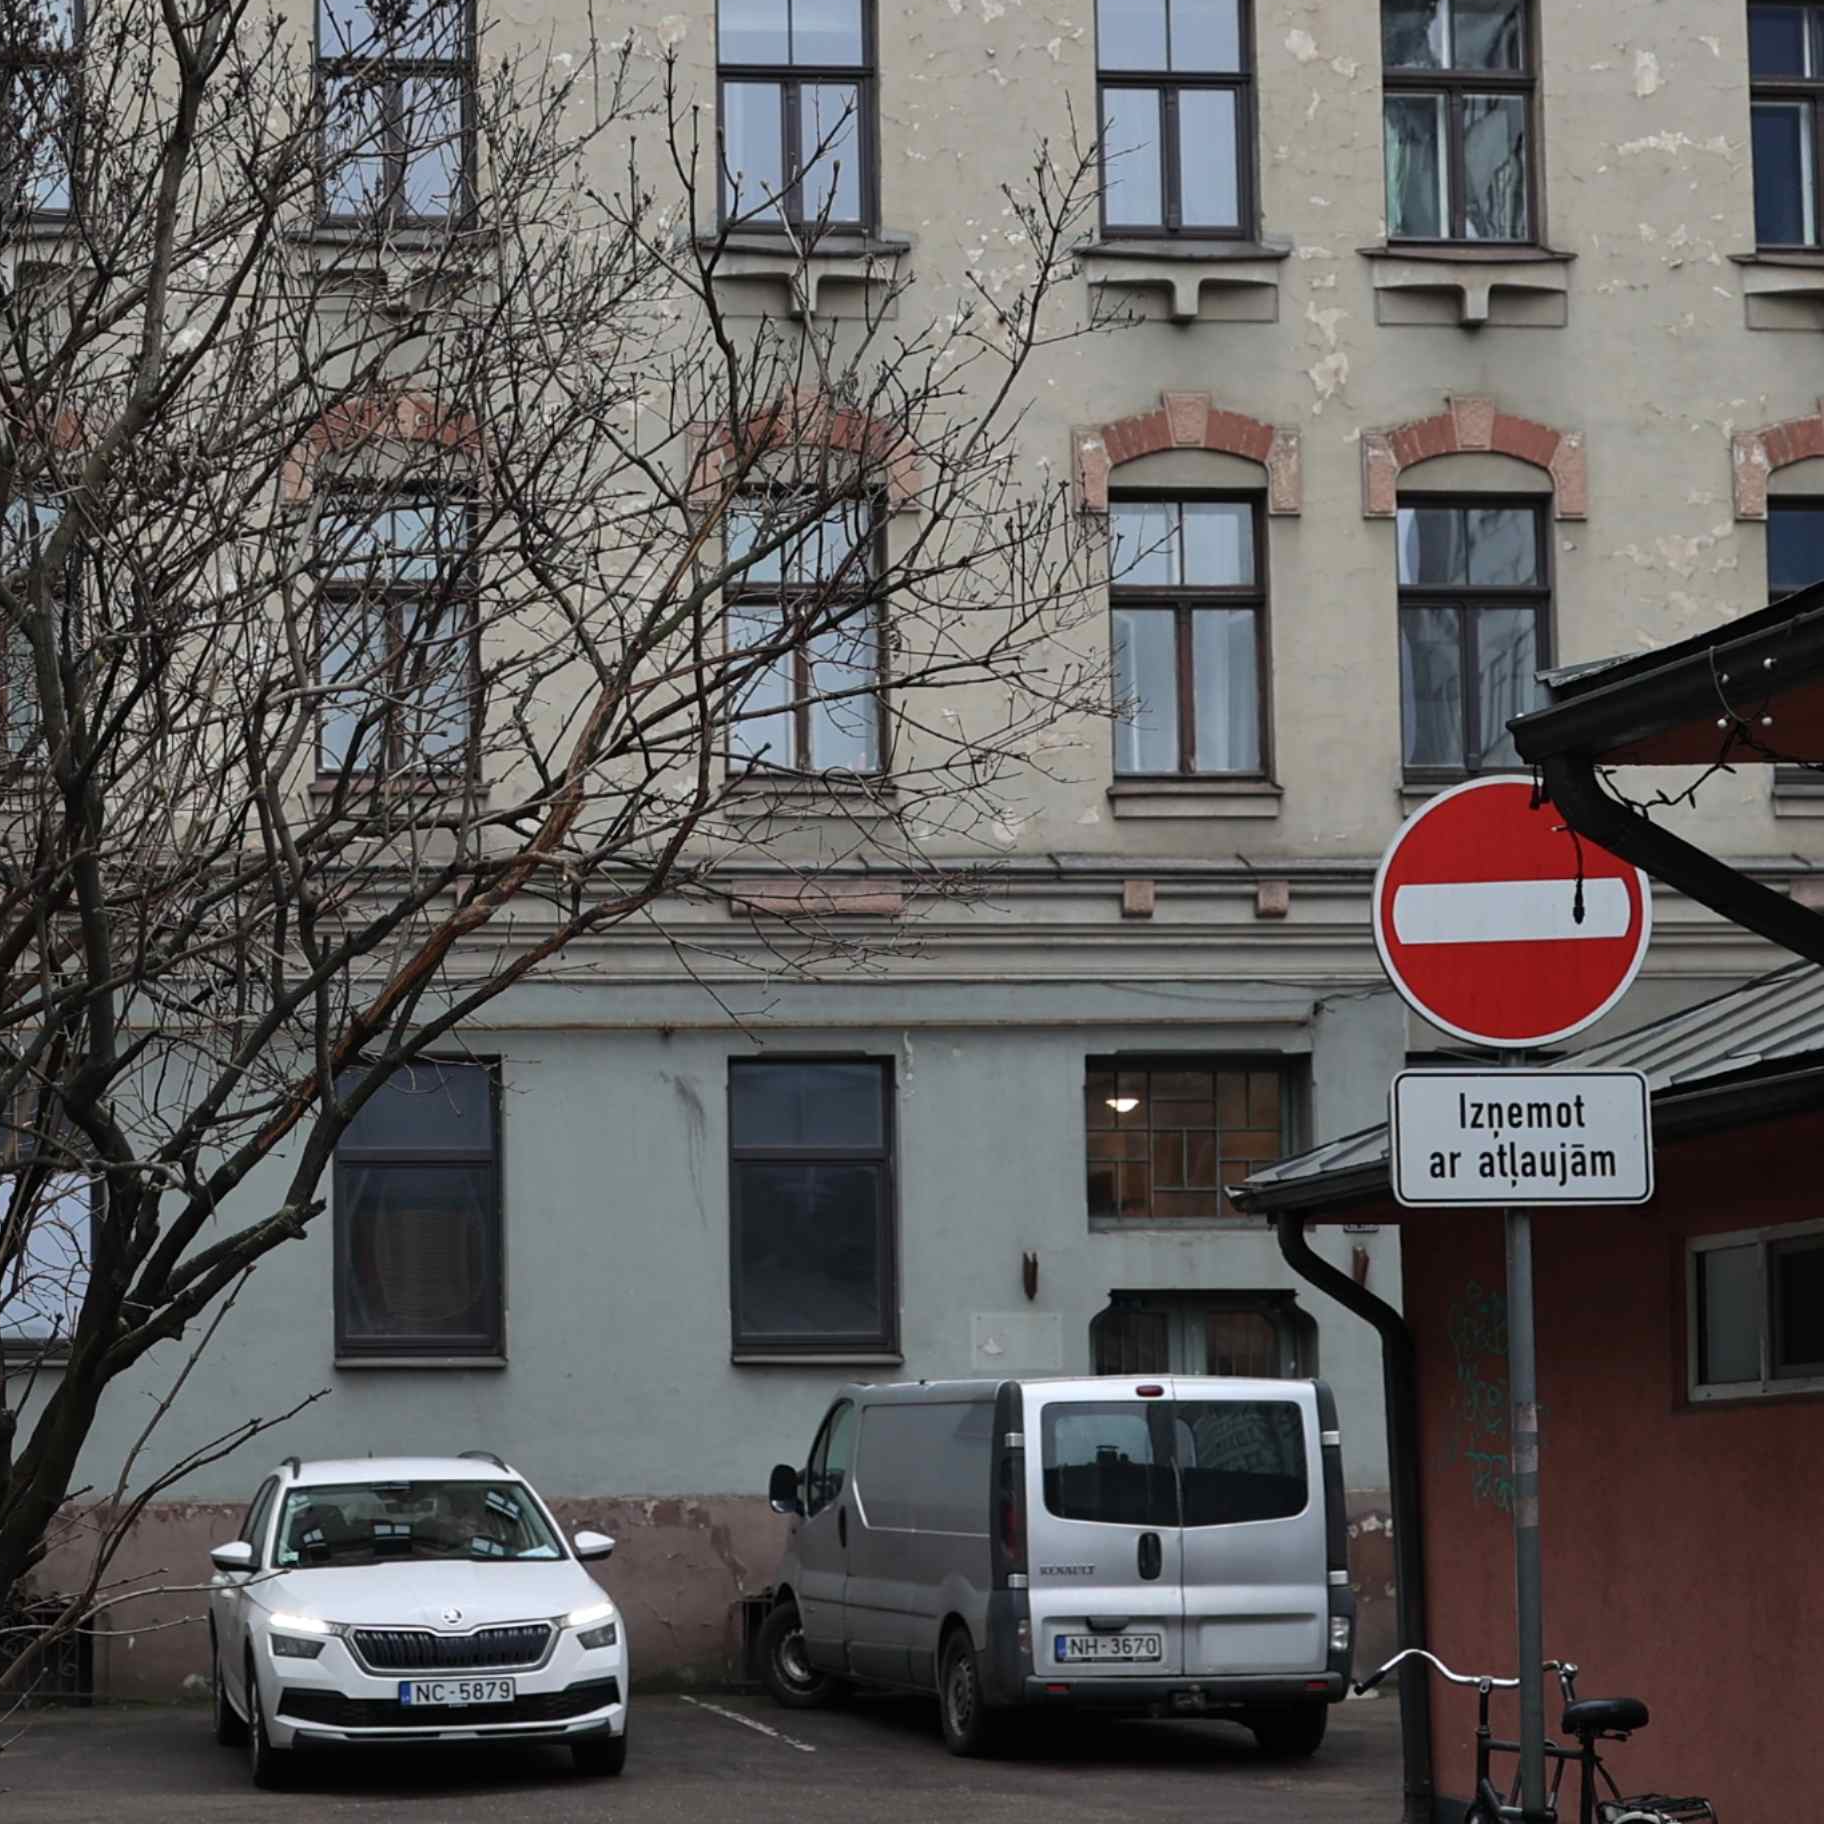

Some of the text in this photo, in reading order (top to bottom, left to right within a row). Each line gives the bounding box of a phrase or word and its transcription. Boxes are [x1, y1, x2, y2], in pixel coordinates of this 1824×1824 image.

[1459, 1092, 1585, 1139] Izņemot
[1429, 1142, 1616, 1188] ar atļaujām
[1040, 1565, 1096, 1576] RENAULT
[1070, 1637, 1157, 1655] NH-3670
[416, 1681, 511, 1703] NC-5879
